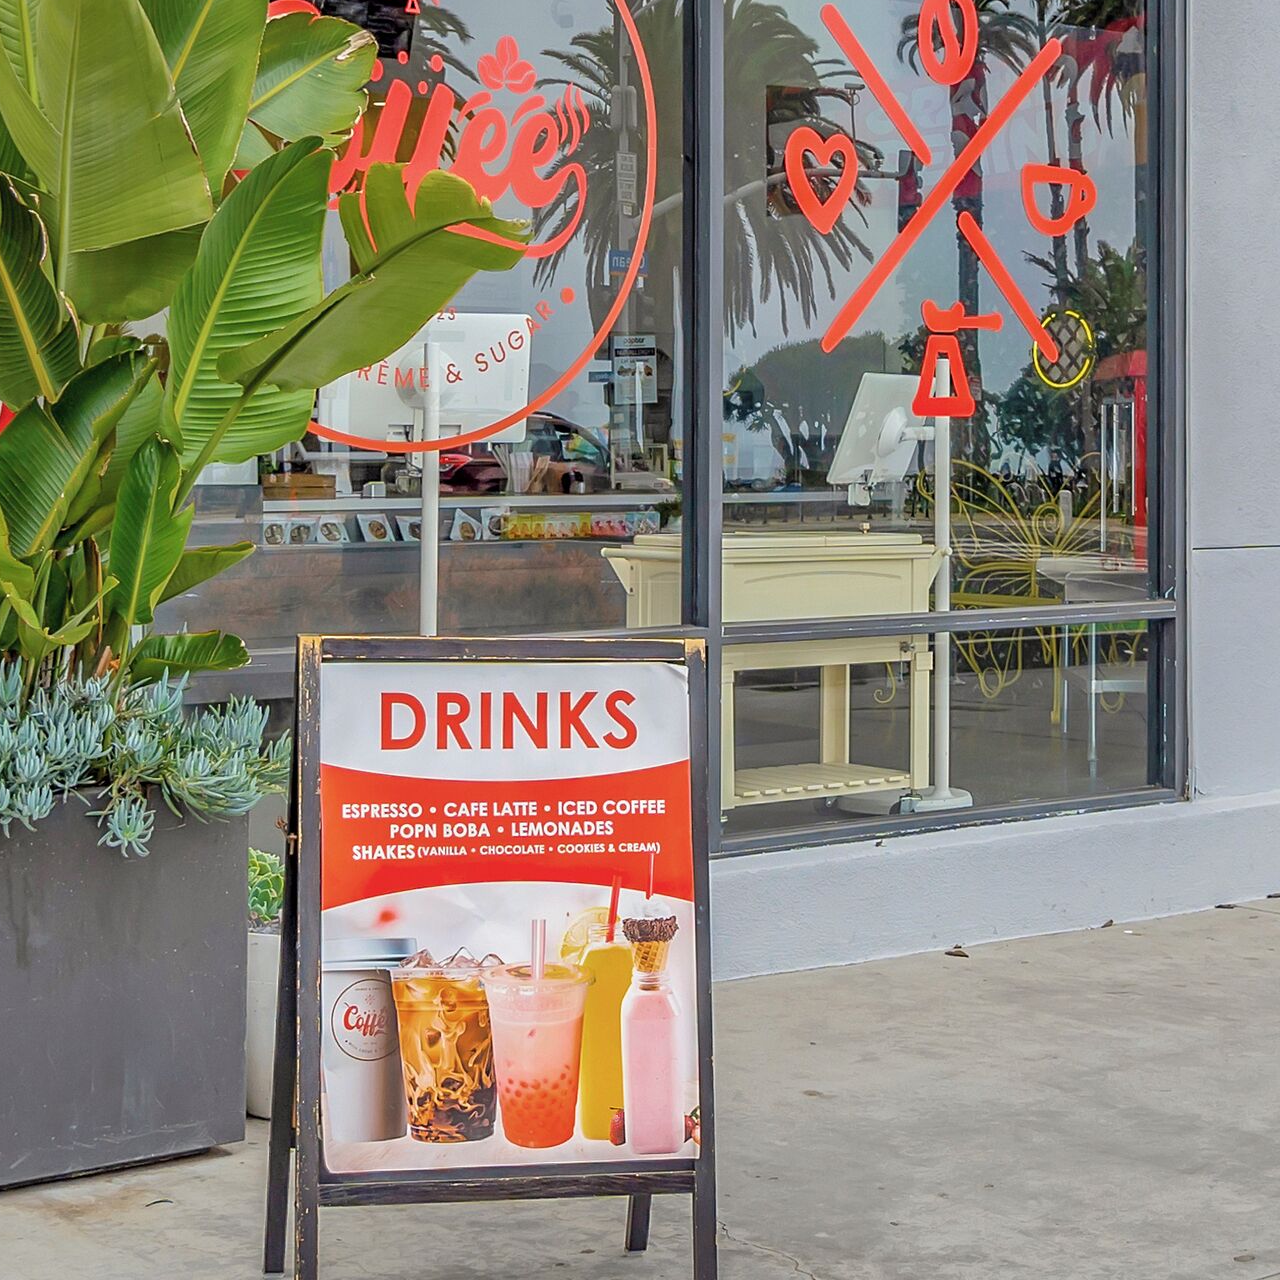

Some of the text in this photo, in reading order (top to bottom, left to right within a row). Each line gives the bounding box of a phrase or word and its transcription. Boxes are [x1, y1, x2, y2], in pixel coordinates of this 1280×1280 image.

[357, 299, 556, 390] RÈME & SUGAR
[380, 690, 638, 751] DRINKS
[341, 799, 666, 819] ESPRESSO CAFE LATTE ICED COFFEE
[389, 821, 614, 839] POPN BOBA LEMONADES
[352, 841, 661, 861] SHAKES (VANILLA CHOCOLATE COOKIES & CREAM)
